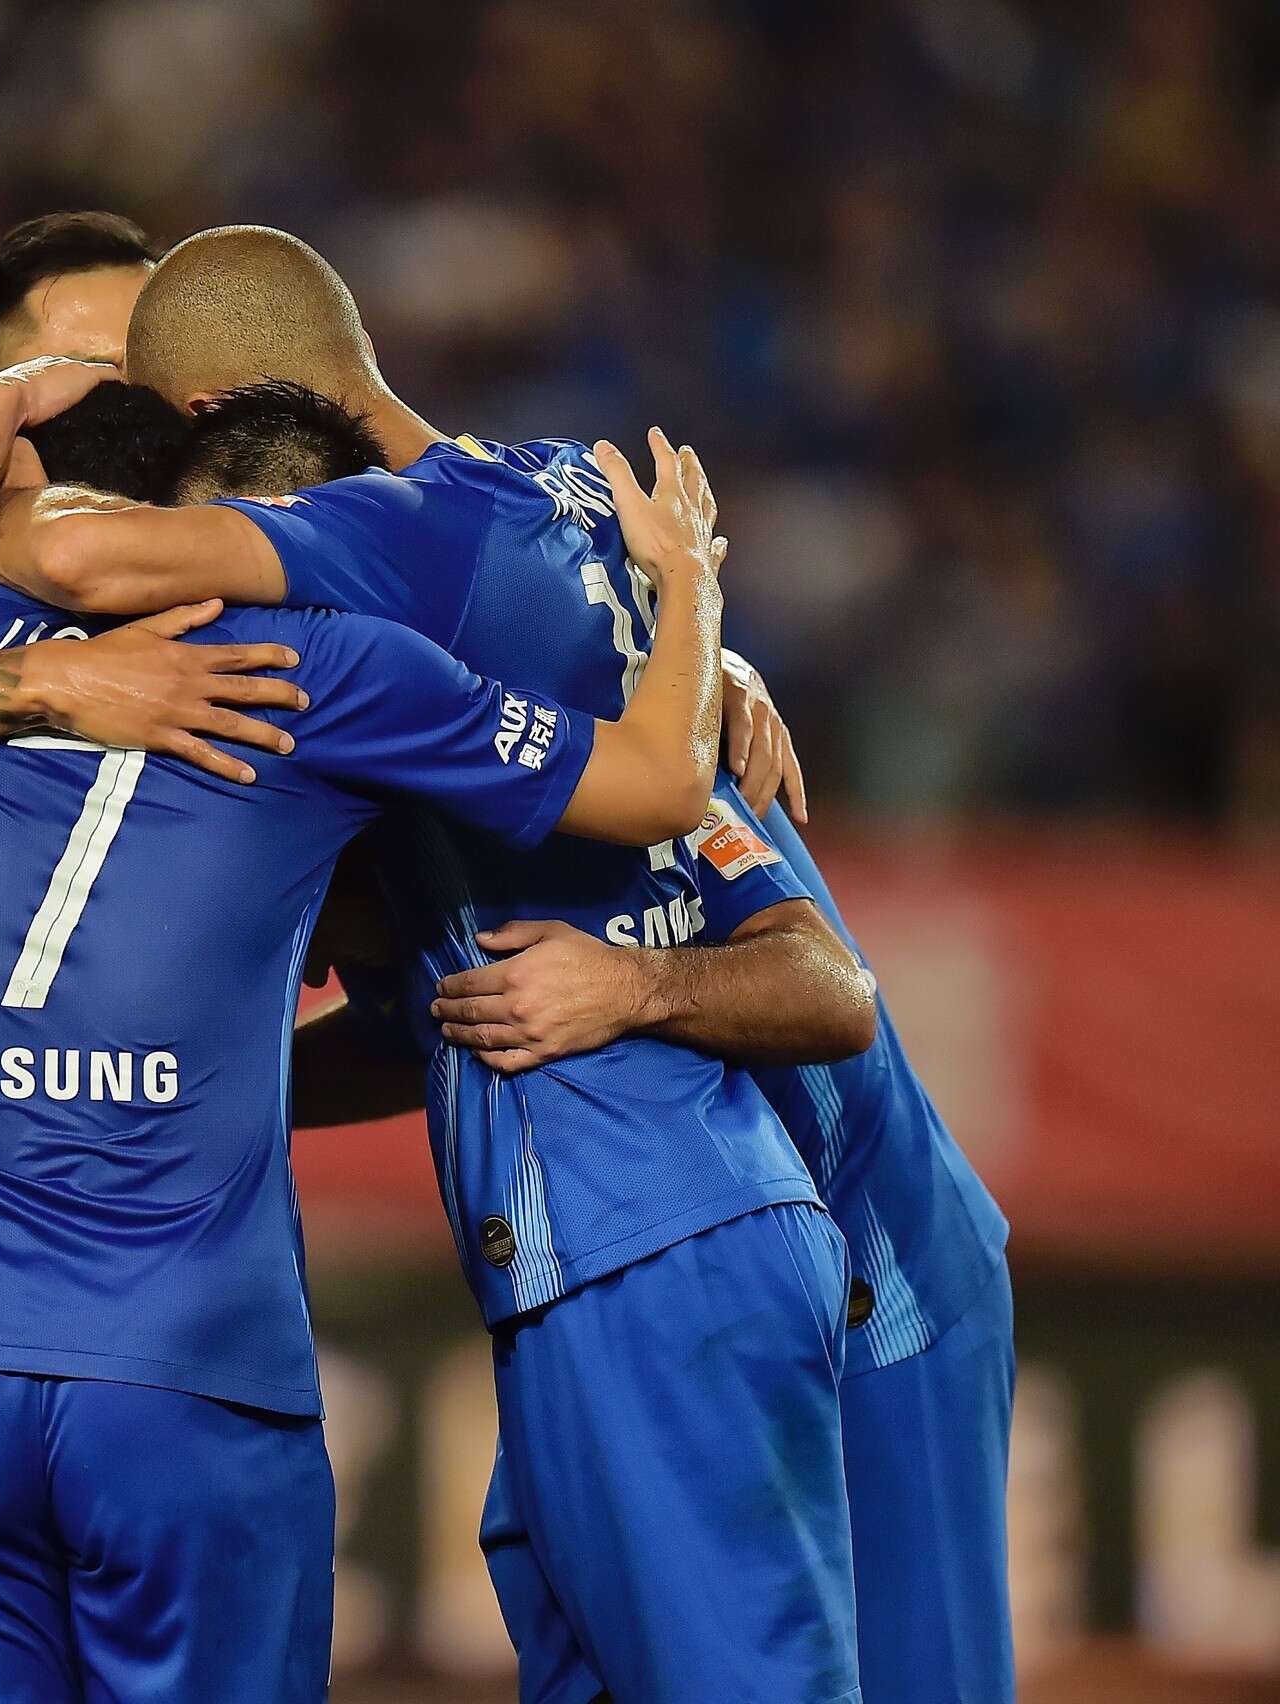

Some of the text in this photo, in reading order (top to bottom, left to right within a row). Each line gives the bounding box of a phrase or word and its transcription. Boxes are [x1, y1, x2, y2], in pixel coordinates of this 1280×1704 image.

[494, 693, 528, 765] AUX
[517, 705, 558, 771] 奥克斯
